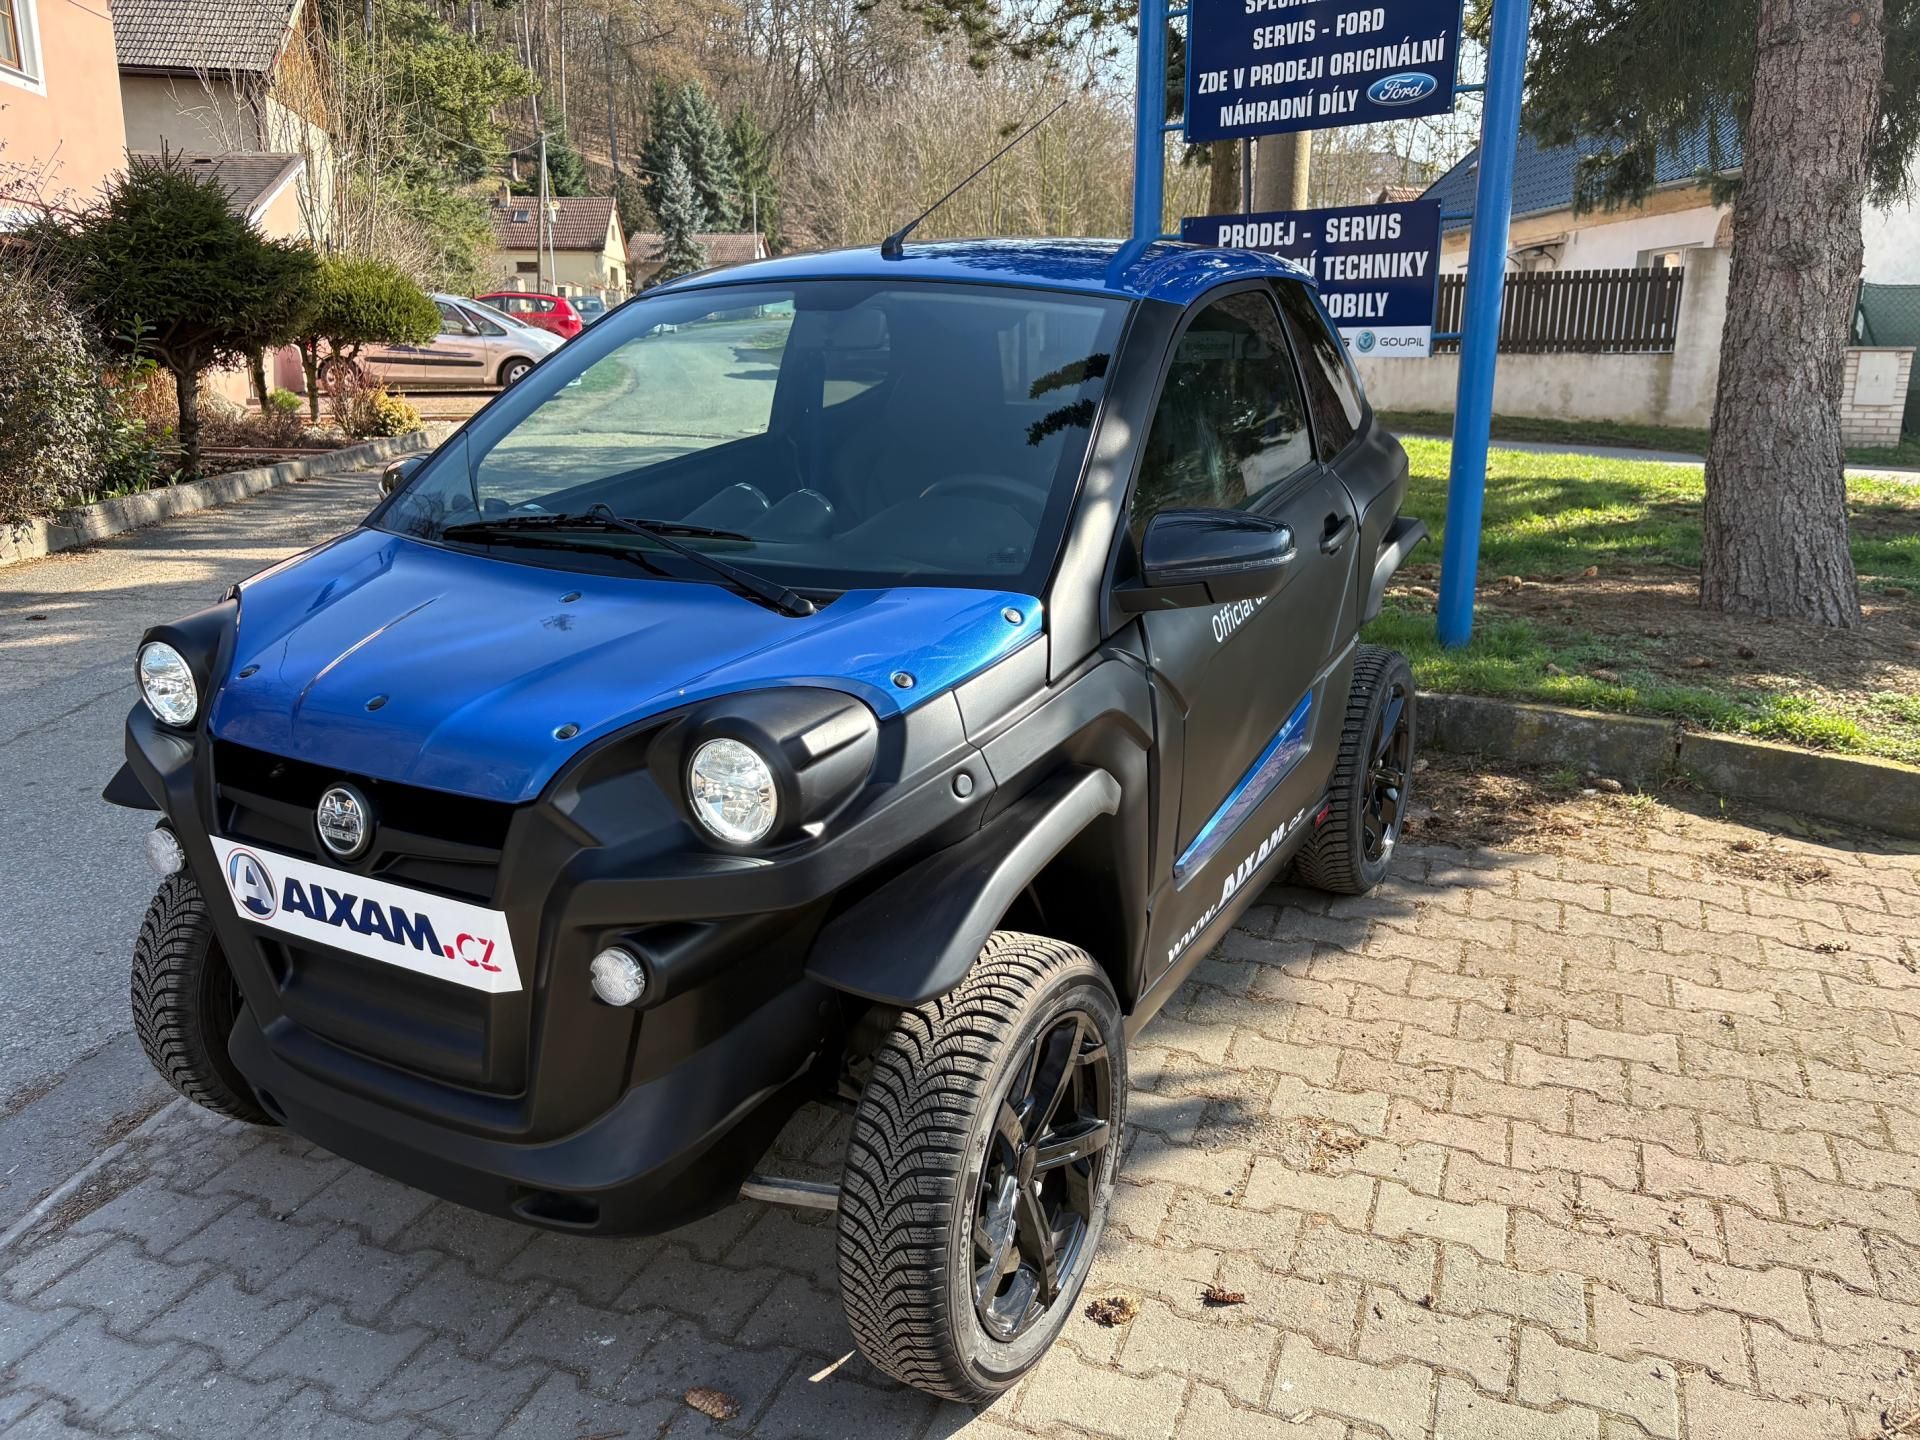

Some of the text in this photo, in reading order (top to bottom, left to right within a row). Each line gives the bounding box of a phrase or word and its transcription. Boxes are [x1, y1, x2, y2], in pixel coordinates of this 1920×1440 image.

[1253, 20, 1316, 50] SERVIS
[1336, 8, 1385, 37] FORD
[1198, 30, 1447, 94] ZDE V PRODEJI ORIGINÁLNÍ
[1220, 85, 1359, 127] NÁHRADNÍ DÍLY
[1379, 78, 1423, 101] Ford
[1218, 221, 1296, 248] PRODEJ
[1325, 213, 1402, 243] SERVIS
[1323, 251, 1429, 281] TECHNIKY
